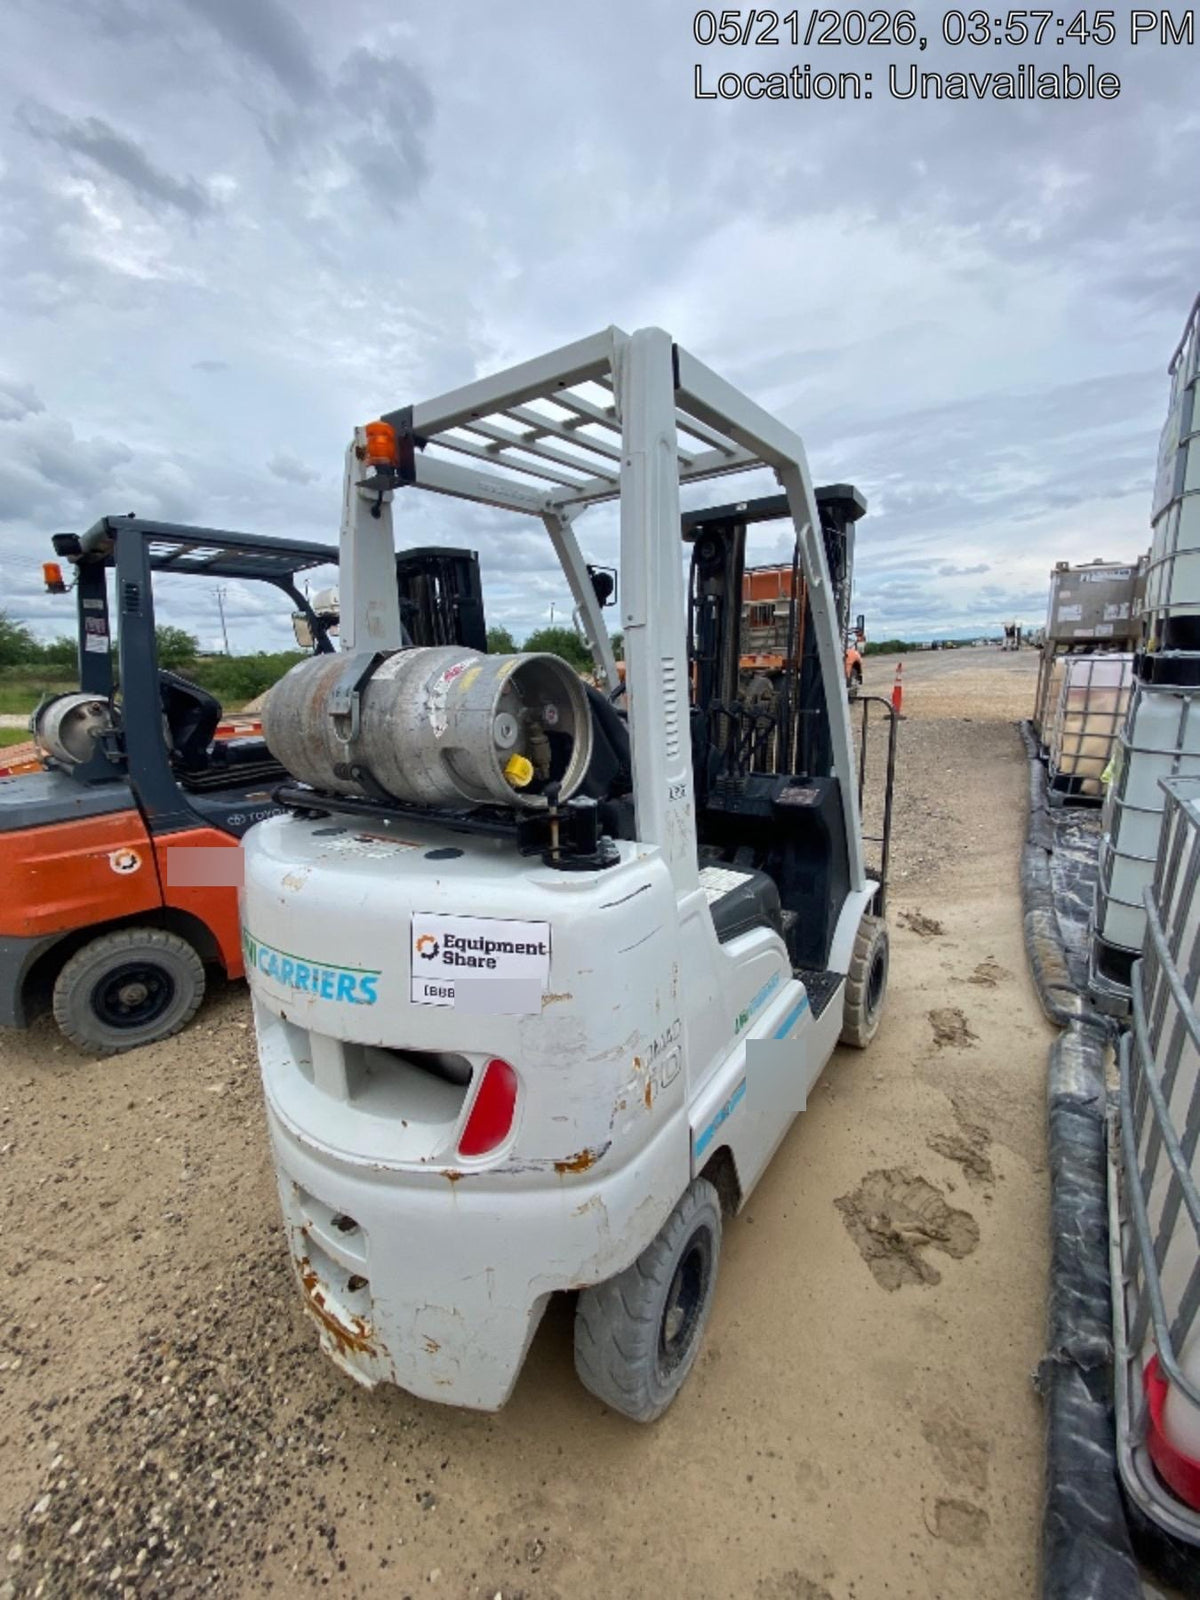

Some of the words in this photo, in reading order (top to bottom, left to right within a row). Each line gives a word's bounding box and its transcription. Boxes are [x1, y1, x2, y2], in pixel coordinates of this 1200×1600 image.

[443, 933, 547, 956] Equipment
[242, 929, 379, 1005] NICARRIERS
[442, 950, 497, 969] Share
